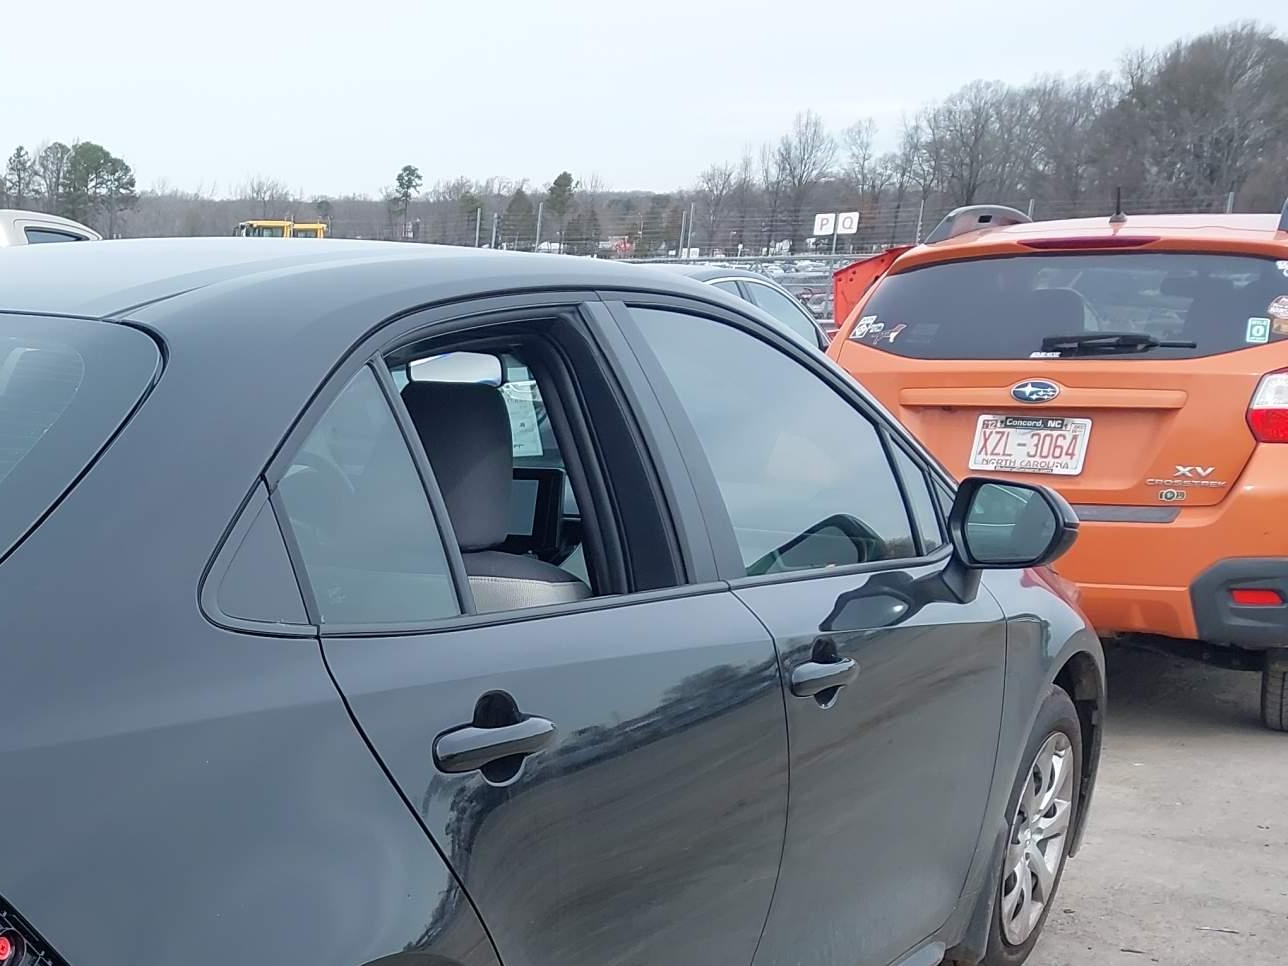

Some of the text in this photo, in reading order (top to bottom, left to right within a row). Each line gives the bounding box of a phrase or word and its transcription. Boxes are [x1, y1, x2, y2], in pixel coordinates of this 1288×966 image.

[819, 217, 830, 231] P
[842, 215, 854, 230] Q
[1006, 418, 1062, 429] Concord, NC
[1173, 465, 1215, 477] XV
[1145, 478, 1227, 488] CROSSTREK
